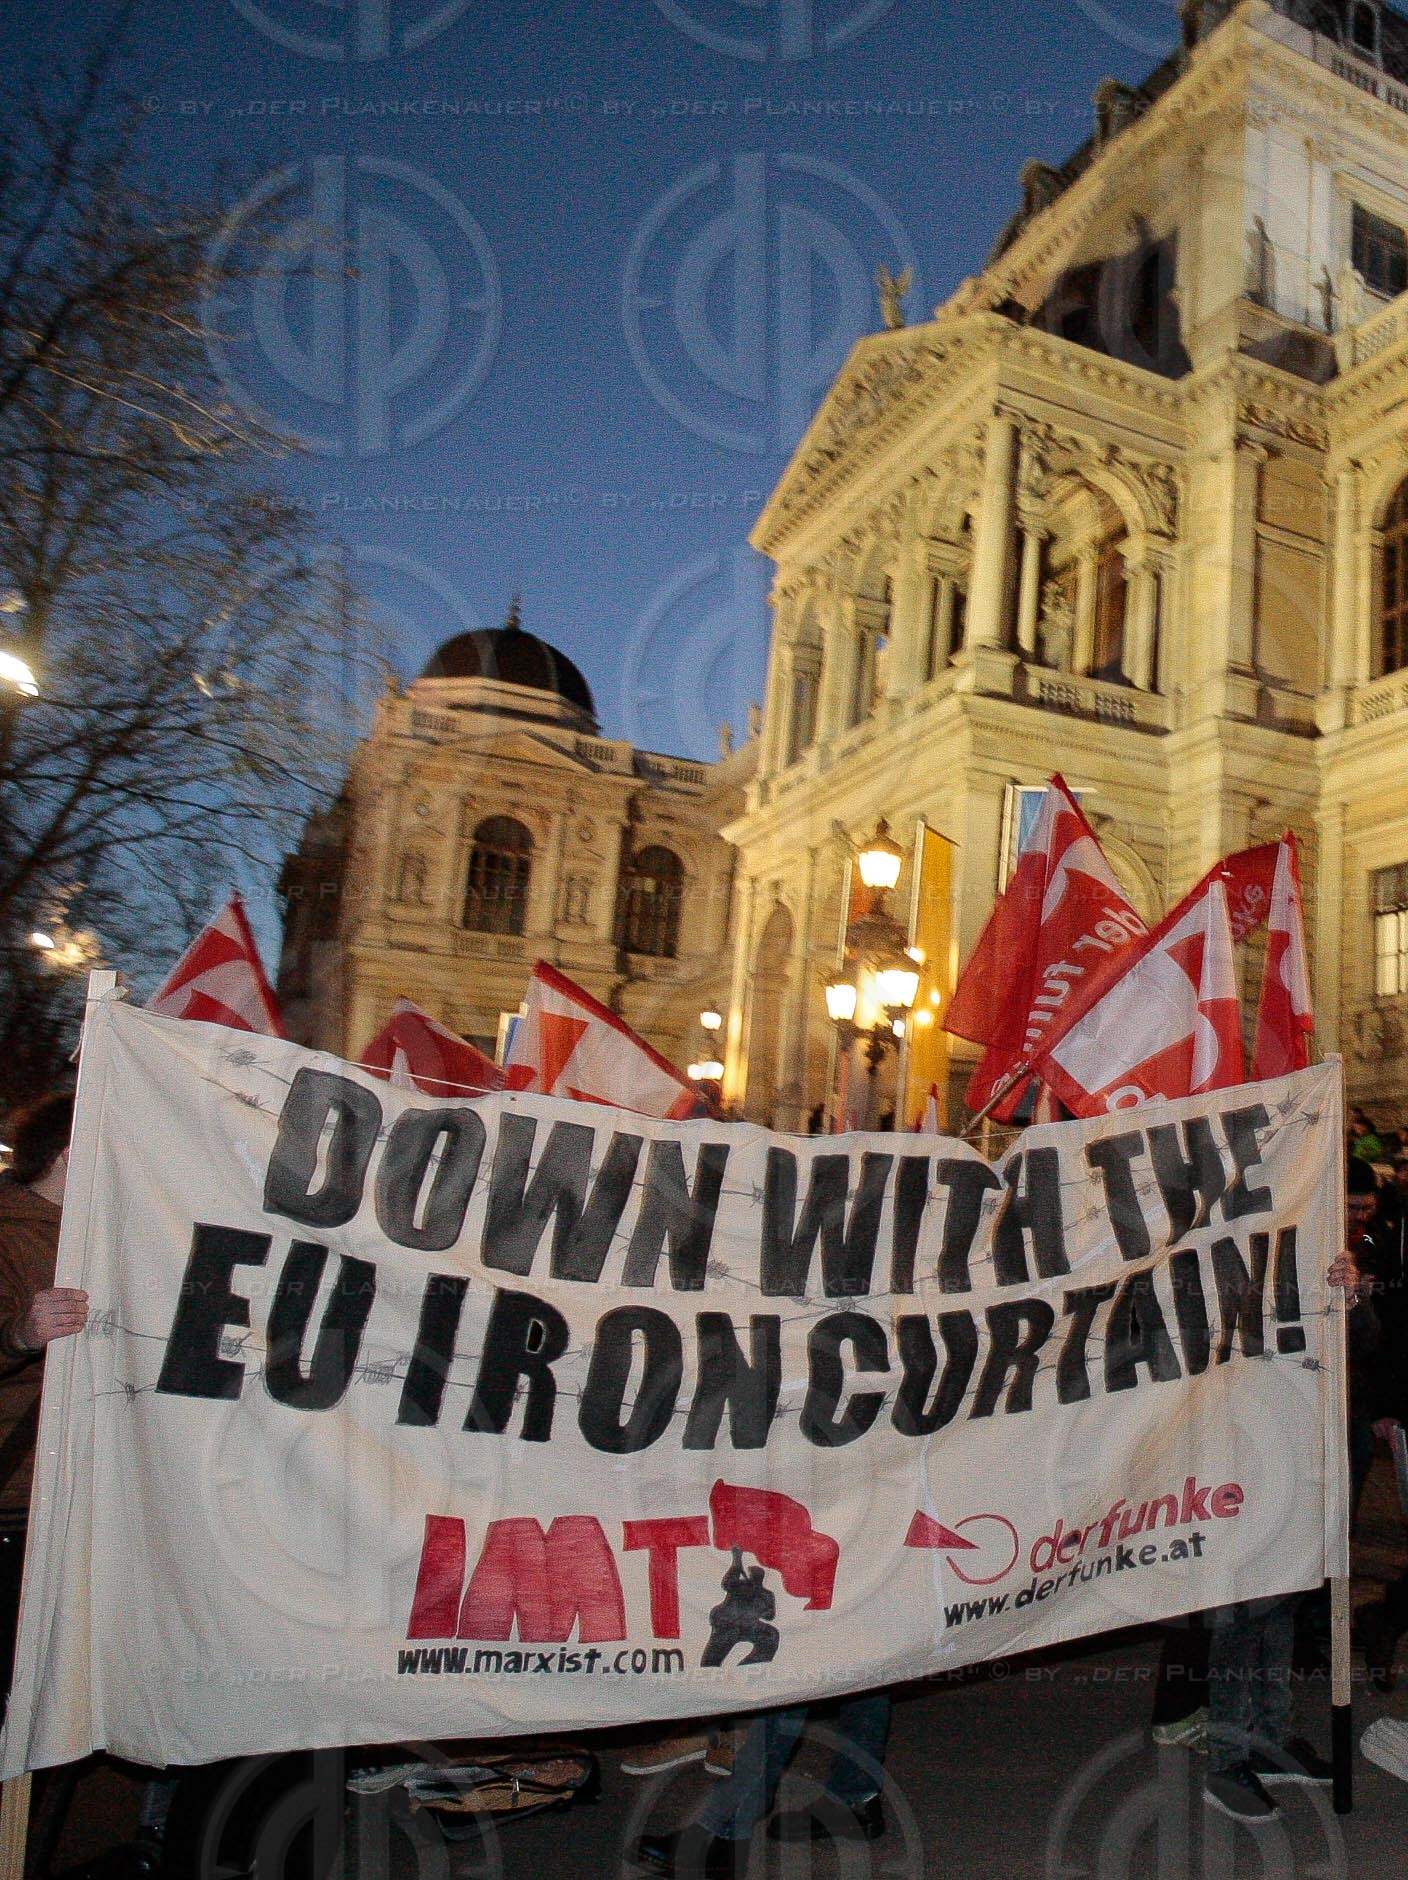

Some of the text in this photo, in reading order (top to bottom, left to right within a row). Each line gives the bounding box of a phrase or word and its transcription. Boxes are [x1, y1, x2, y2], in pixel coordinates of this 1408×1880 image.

[263, 1067, 1274, 1298] DOWN WITH THE
[155, 1221, 1307, 1454] EU IRON CURTAIN!
[406, 1513, 712, 1644] IMT
[943, 1531, 1207, 1629] www.derfunke.at
[397, 1646, 685, 1676] www.marxist.com
